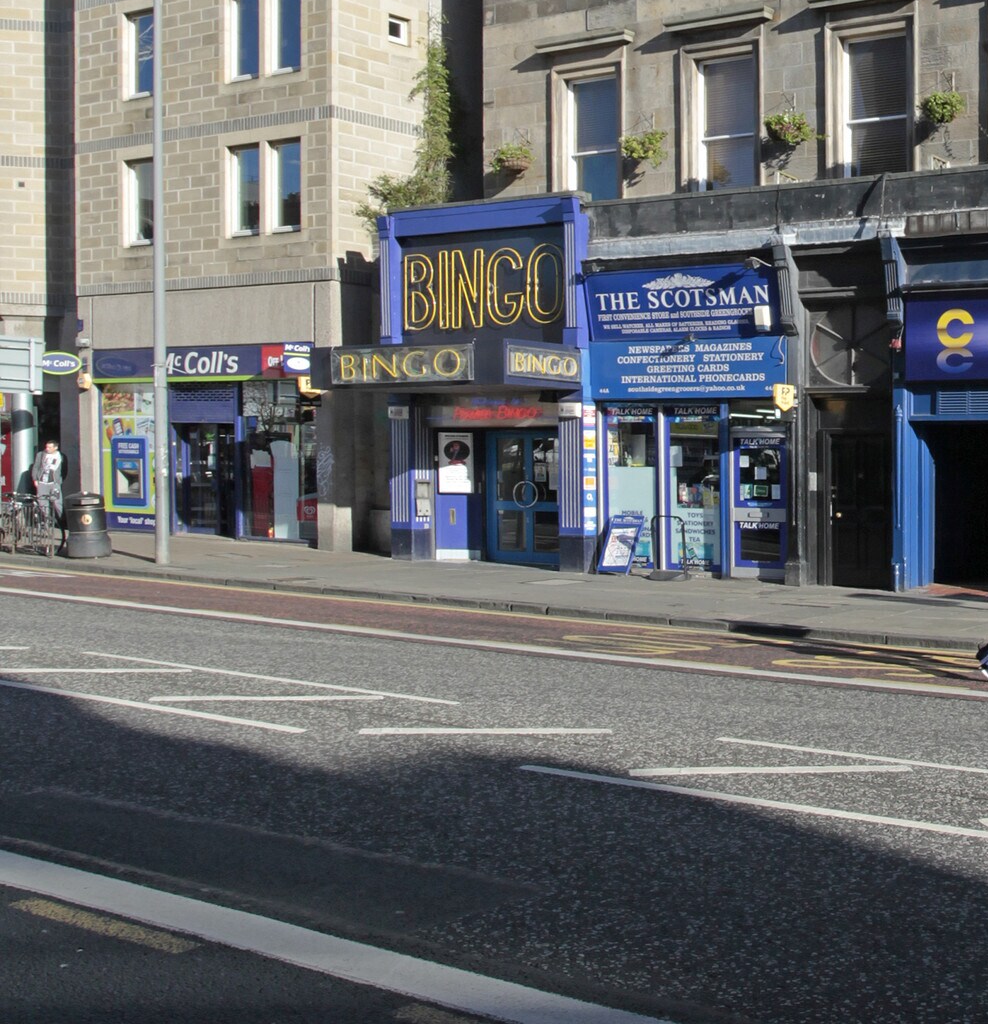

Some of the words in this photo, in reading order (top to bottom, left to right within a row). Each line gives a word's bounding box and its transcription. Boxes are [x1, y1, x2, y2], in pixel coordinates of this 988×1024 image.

[404, 243, 565, 331] BINGO
[595, 292, 641, 311] THE
[647, 284, 769, 310] SCOTSMAN
[628, 344, 690, 355] NEWSPAPERS
[695, 342, 752, 353] MAGAZINES
[617, 353, 695, 364] CONFECTIONERY
[703, 352, 764, 362] STATIONERY
[340, 349, 461, 382] BINGO
[514, 353, 577, 377] BINGO
[647, 364, 695, 373] GREETING
[697, 363, 729, 372] CARDS
[621, 374, 697, 384] INTERNATIONAL
[698, 372, 765, 382] PHONECARDS
[612, 407, 631, 416] TALK
[631, 407, 654, 416] HOME
[674, 407, 694, 415] TALK
[694, 406, 717, 414] HOME
[740, 438, 759, 446] TALK
[759, 437, 781, 445] HOME
